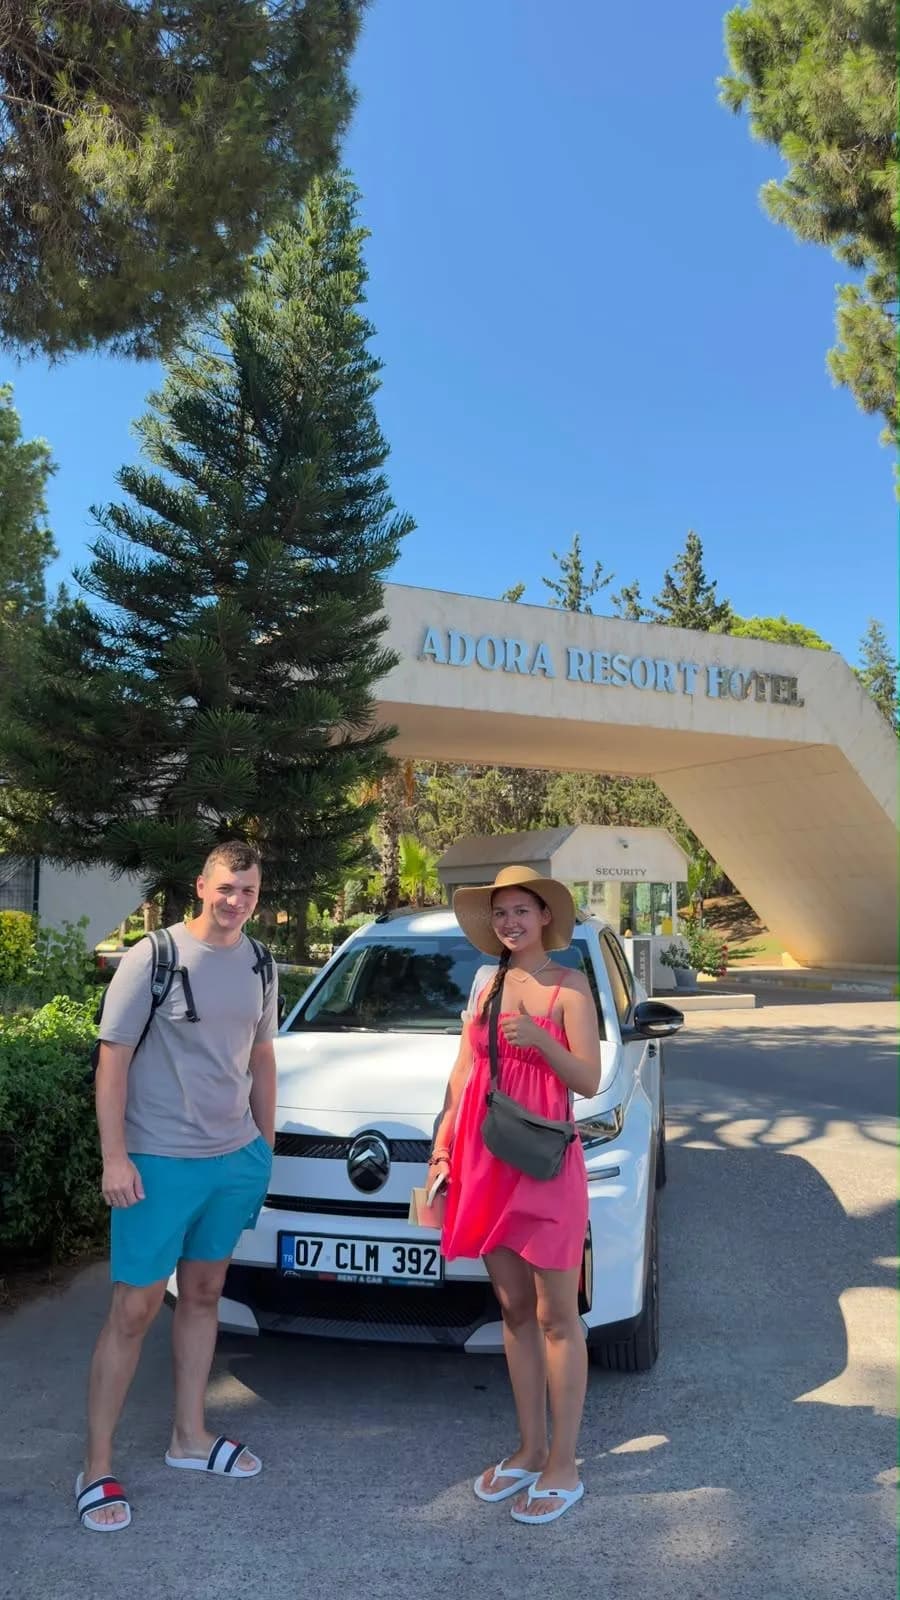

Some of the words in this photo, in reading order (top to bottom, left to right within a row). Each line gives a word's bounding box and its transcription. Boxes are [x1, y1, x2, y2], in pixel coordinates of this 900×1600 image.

[417, 625, 557, 678] ADORA
[567, 647, 700, 695] RESORT
[706, 664, 805, 707] HOTEL
[594, 867, 648, 877] SECURITY
[283, 1254, 294, 1263] TR
[295, 1239, 324, 1268] 07
[335, 1242, 379, 1273] CLM
[392, 1245, 437, 1276] 392
[337, 1274, 357, 1283] RENT
[366, 1276, 382, 1284] CAR
